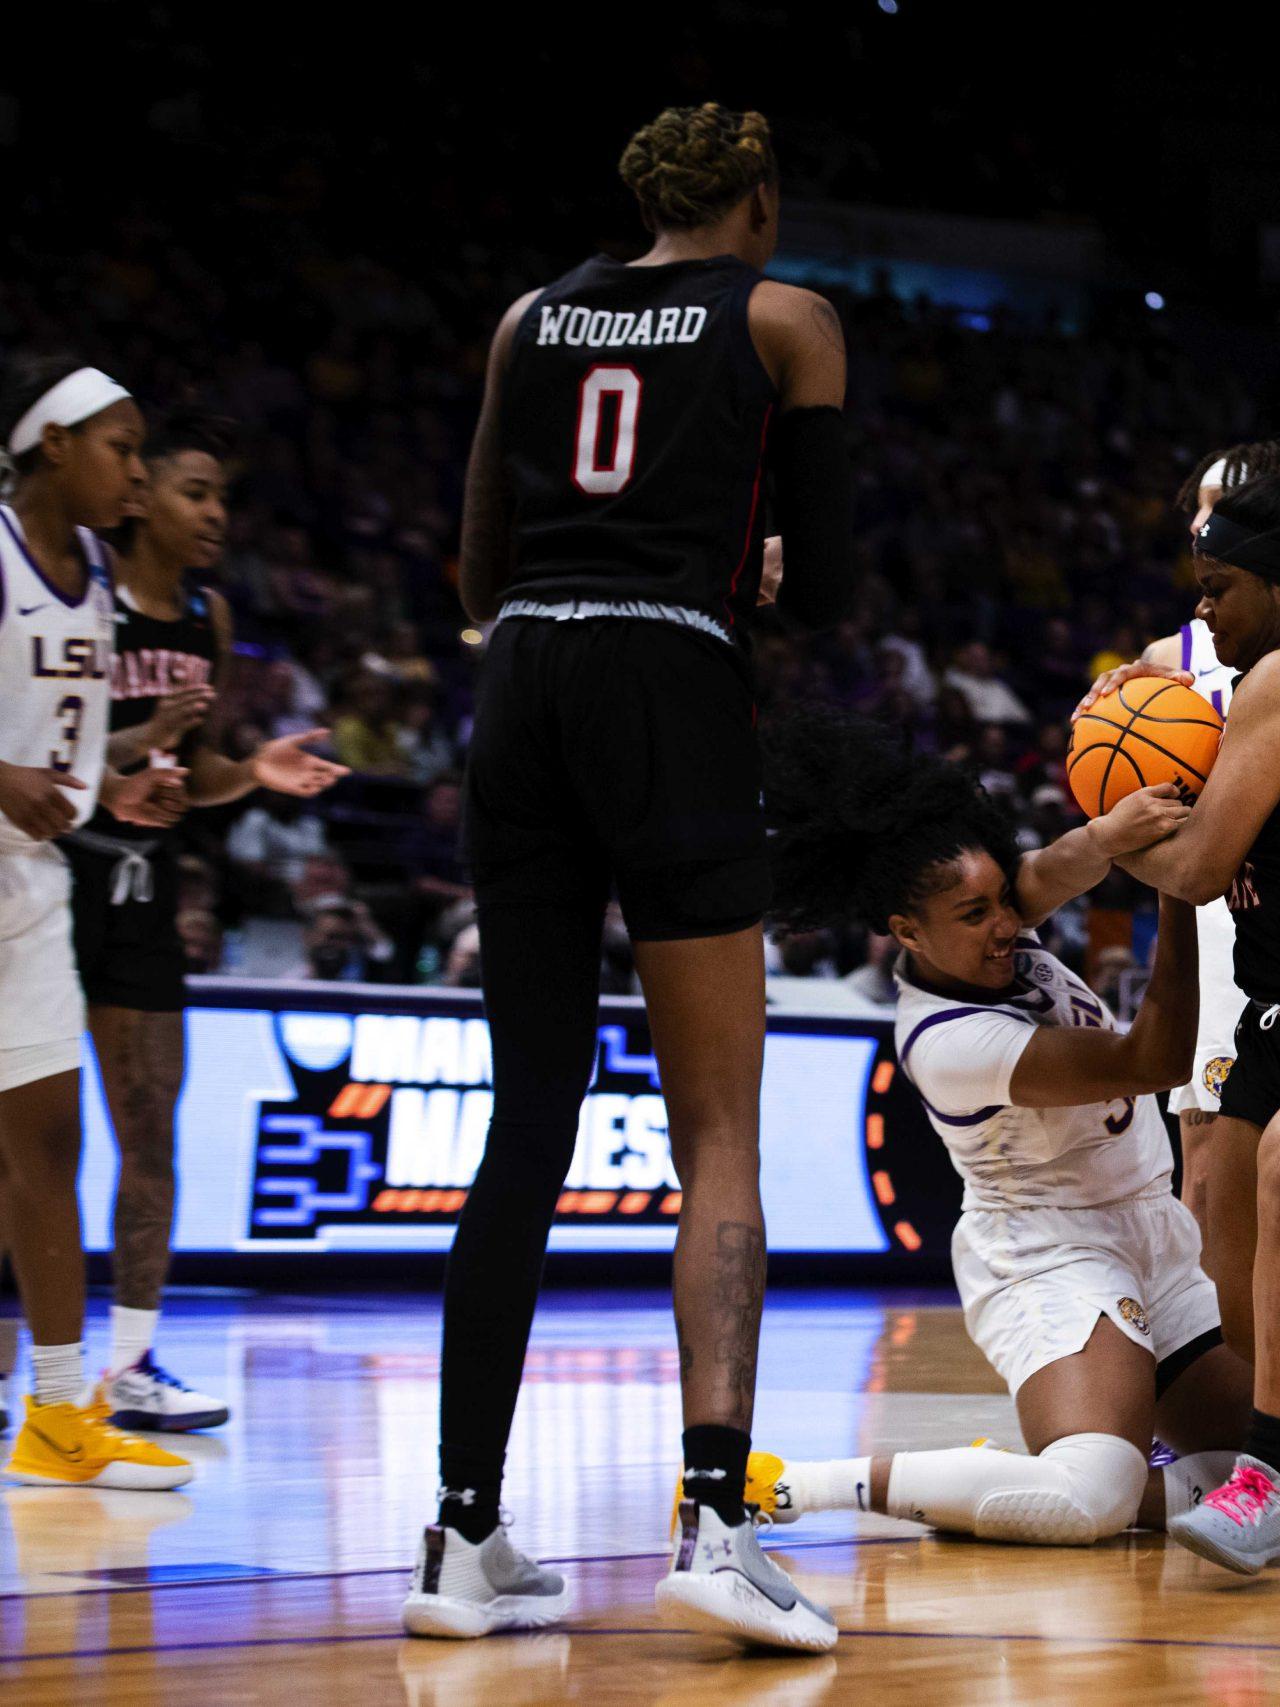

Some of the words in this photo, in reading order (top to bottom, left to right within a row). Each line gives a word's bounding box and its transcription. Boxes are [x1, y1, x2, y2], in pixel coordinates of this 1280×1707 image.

[536, 304, 708, 348] WOODARD
[570, 362, 644, 498] 0
[50, 694, 84, 773] 3
